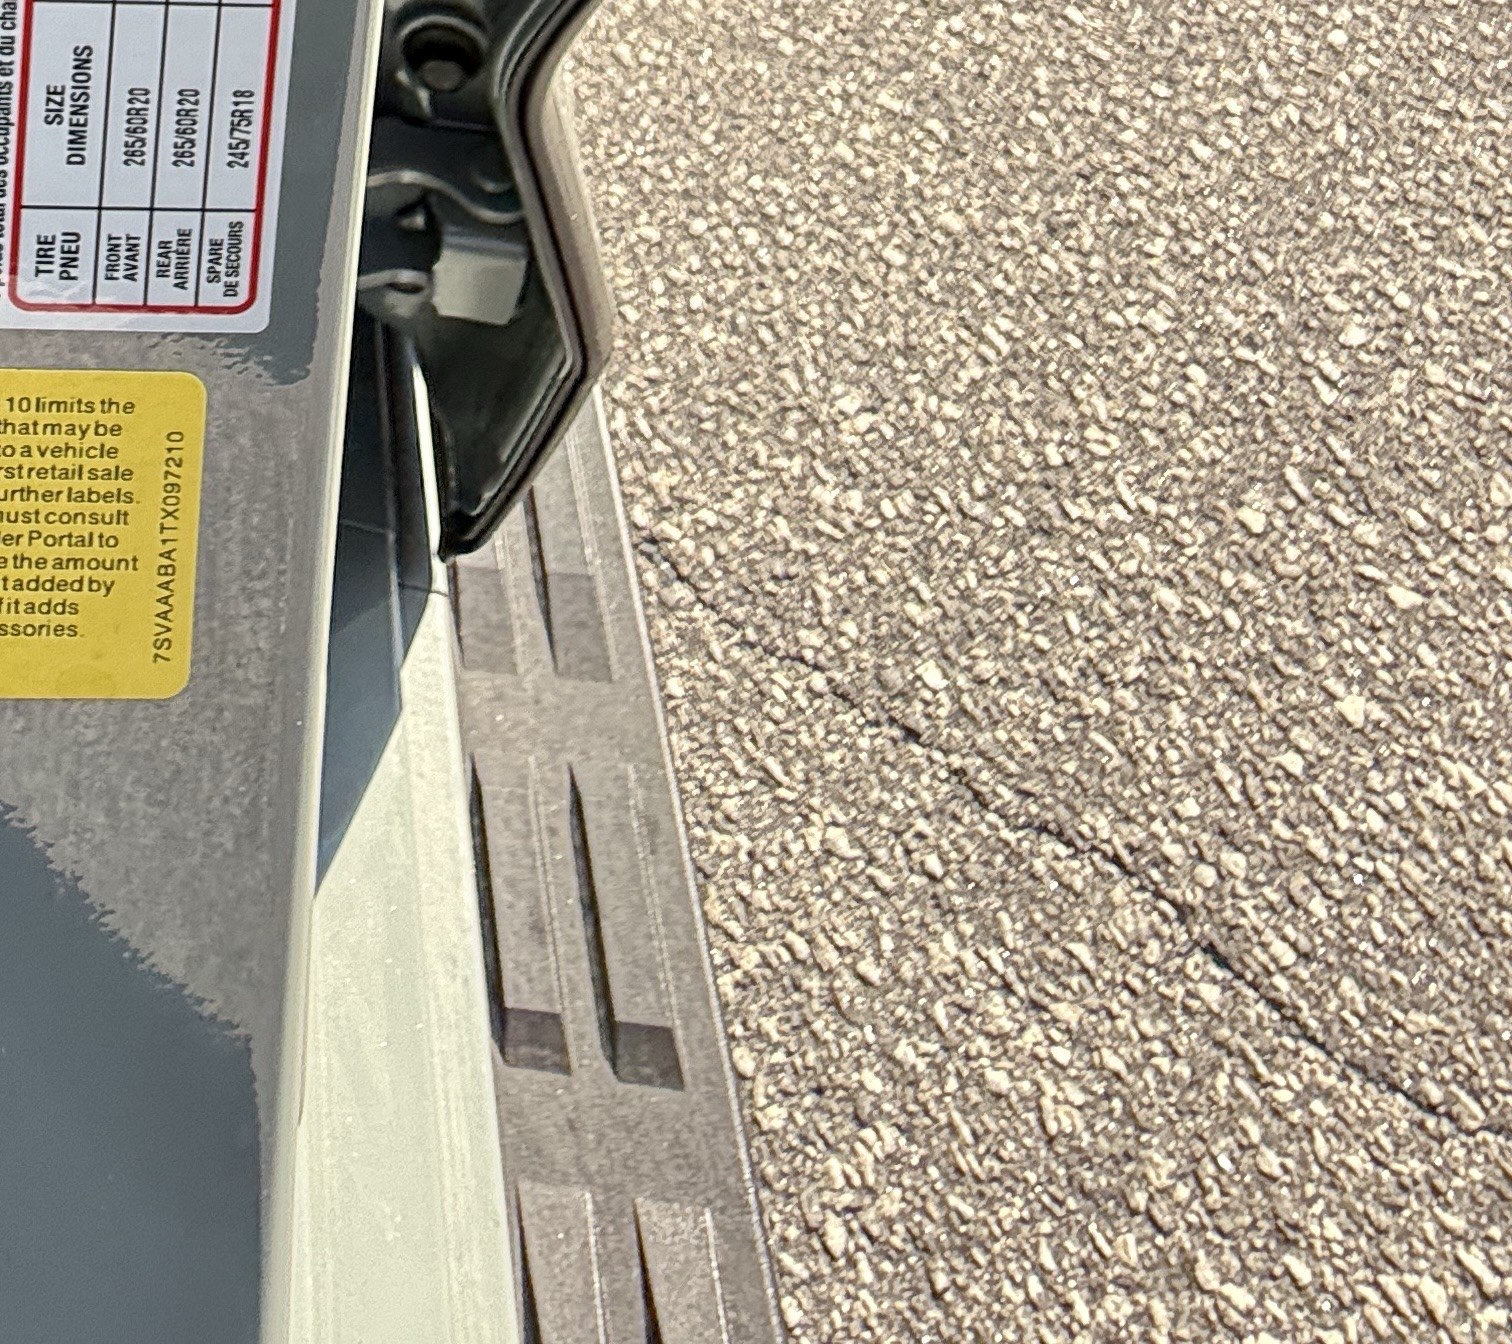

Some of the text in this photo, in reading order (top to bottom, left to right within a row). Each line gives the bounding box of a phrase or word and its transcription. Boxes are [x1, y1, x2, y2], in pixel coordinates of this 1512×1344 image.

[43, 84, 66, 126] SIZE
[65, 45, 93, 166] DIMENSIONS
[122, 87, 151, 167] 265/60R20
[171, 88, 200, 168] 265/60R20
[226, 89, 255, 169] 245/75R18
[34, 234, 57, 278] TIRE
[58, 231, 81, 281] PNEU
[104, 233, 123, 281] FRONT
[155, 240, 173, 278] REAR
[206, 238, 225, 284] SPARE
[34, 396, 96, 414] limits
[99, 397, 136, 415] the
[42, 422, 92, 441] may
[93, 419, 123, 437] be
[36, 442, 120, 460] vehicle
[26, 463, 84, 481] retail
[87, 464, 135, 482] sale
[44, 509, 130, 526] consult
[27, 529, 94, 548] Portal
[97, 532, 119, 549] to
[152, 431, 184, 664] 7SVAAABA1TX097210
[12, 552, 48, 571] the
[51, 555, 139, 572] amount
[11, 574, 85, 593] added
[87, 576, 116, 598] by
[23, 597, 80, 616] adds
